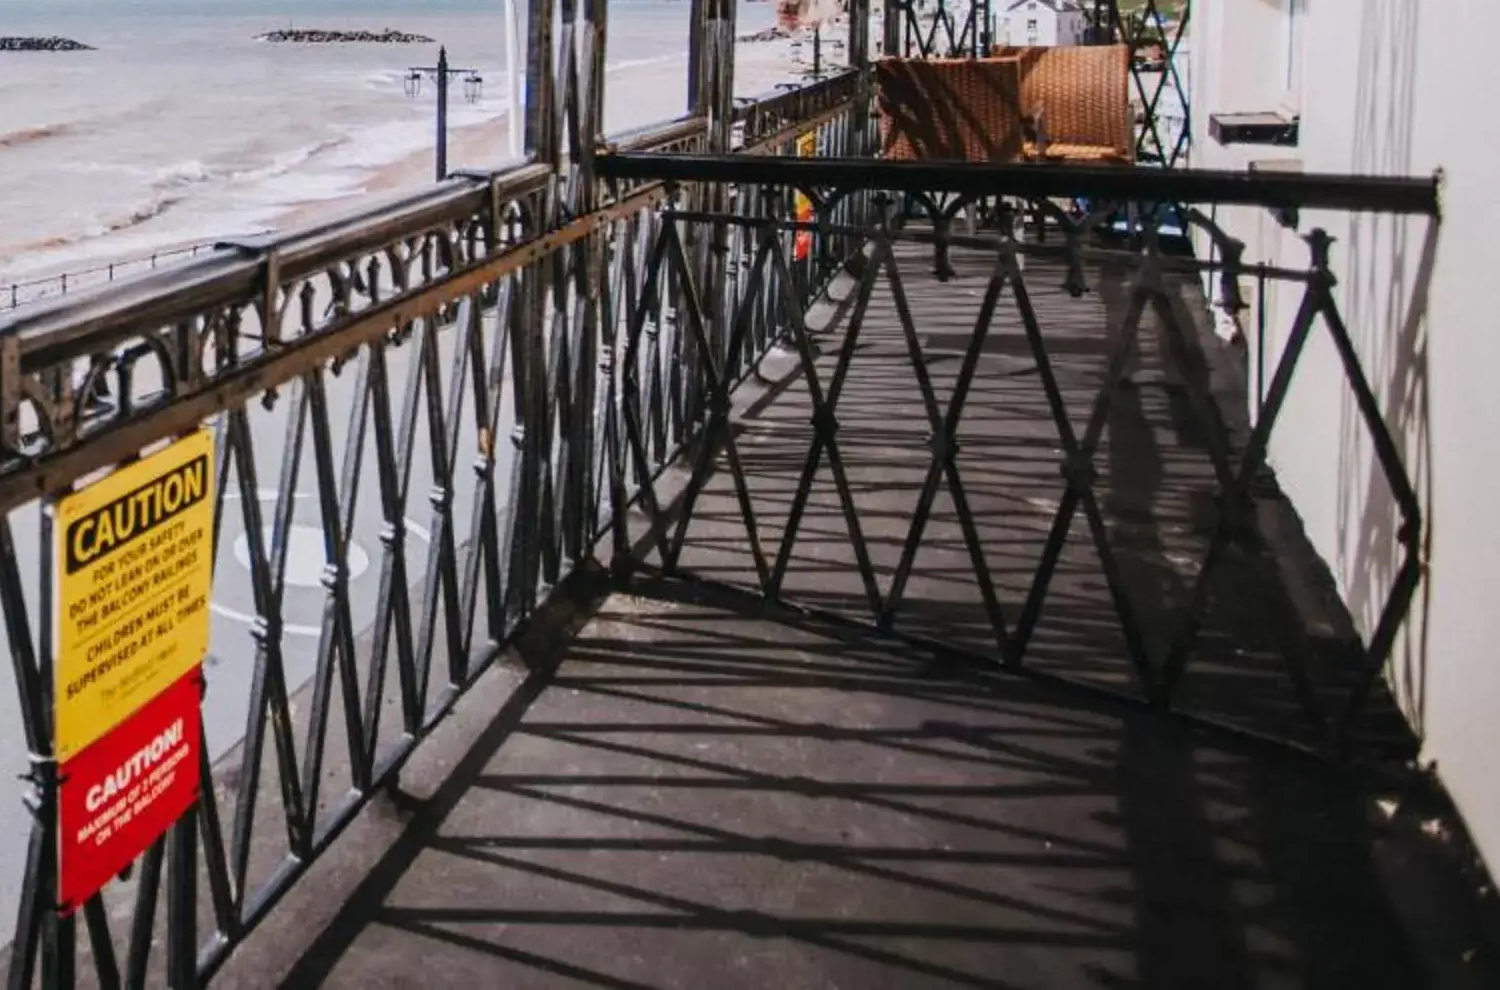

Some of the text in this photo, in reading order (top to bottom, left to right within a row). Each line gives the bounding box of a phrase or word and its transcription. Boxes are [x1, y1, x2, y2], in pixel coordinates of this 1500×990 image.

[74, 461, 203, 562] CAUTION
[92, 521, 186, 583] FOR YOUR SAFETY
[69, 527, 204, 621] DO NOT LEAN ON OR OVER
[76, 549, 198, 635] THE BALCONY RAILINGS
[66, 641, 138, 701] SUPERVISED
[140, 627, 155, 647] AT
[156, 616, 173, 638] ALL
[176, 593, 206, 623] TIMES
[86, 583, 190, 662] CHILDREN MUST BE
[85, 717, 184, 812] CAUTION!
[77, 796, 127, 844] MAXIMUM
